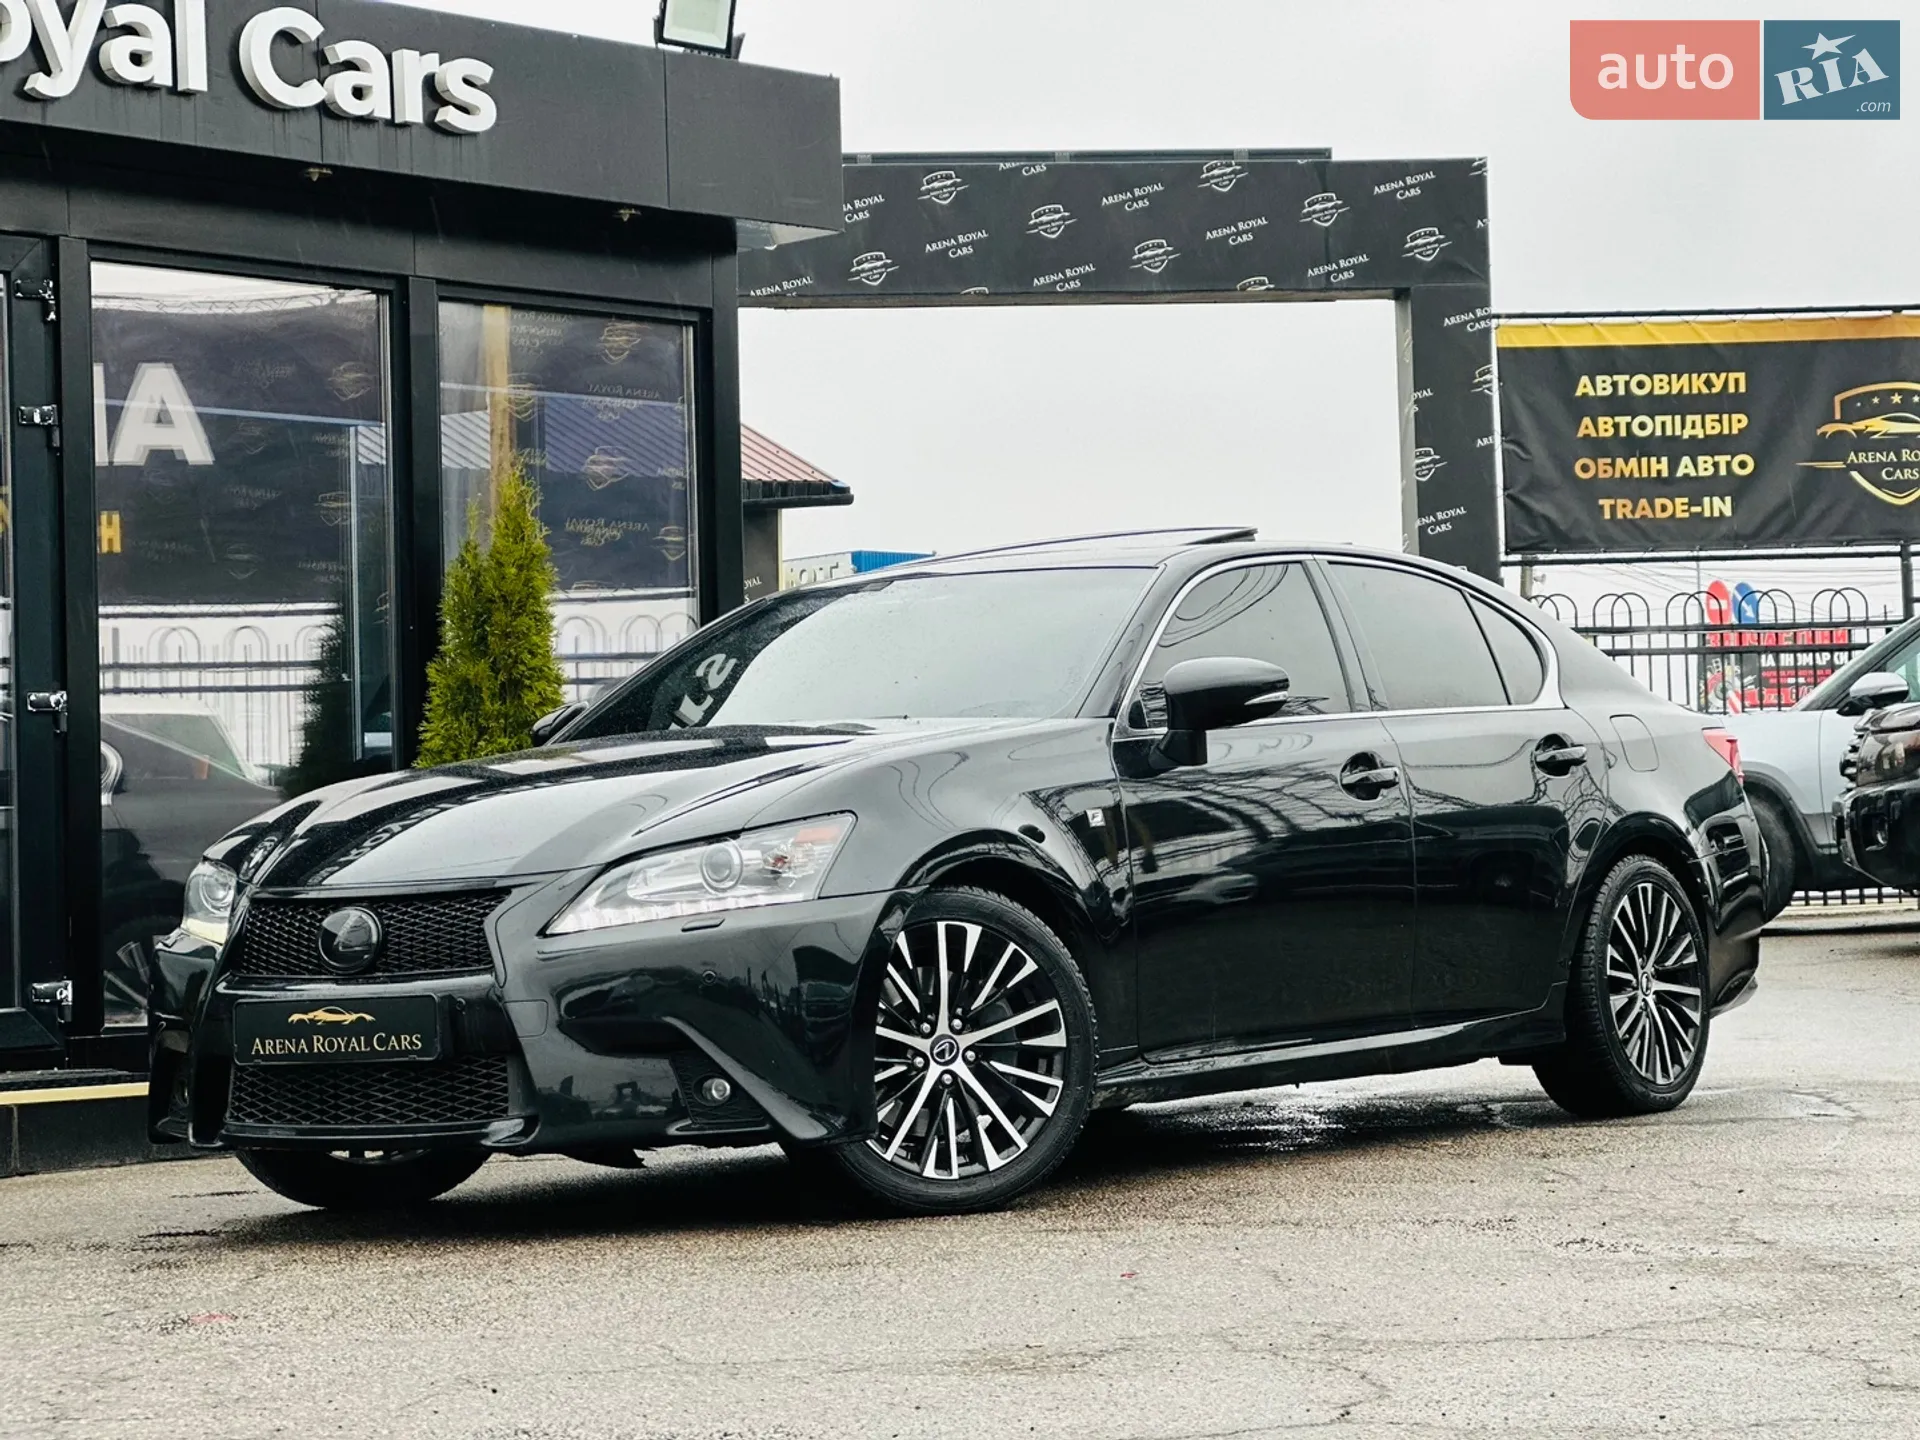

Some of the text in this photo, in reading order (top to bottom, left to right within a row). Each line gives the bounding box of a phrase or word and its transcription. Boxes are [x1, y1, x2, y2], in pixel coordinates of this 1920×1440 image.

[239, 6, 497, 134] Cars
[1373, 170, 1436, 196] ARENA ROYAL
[1101, 182, 1165, 206] ARENA ROYAL
[1396, 186, 1421, 199] CARS
[853, 194, 886, 209] ROYAL
[1125, 198, 1149, 211] CARS
[845, 210, 870, 223] CARS
[1206, 216, 1269, 240] ARENA ROYAL
[925, 229, 989, 253] ARENA ROYAL
[1228, 232, 1254, 246] CARS
[948, 245, 974, 258] CARS
[1307, 253, 1370, 277] ARENA ROYAL
[1033, 263, 1096, 287] ARENA ROYAL
[1330, 269, 1355, 282] CARS
[782, 276, 813, 290] ROYAL
[1055, 279, 1081, 292] CARS
[1443, 312, 1475, 327] ARENA
[1466, 318, 1492, 331] CARS
[1575, 372, 1746, 396] АВТОВИКУП
[1576, 413, 1749, 439] АВТОПІДБІР
[1847, 450, 1898, 464] ARENA
[1574, 454, 1755, 479] ОБМІН АВТО
[1881, 467, 1920, 480] CARS
[1436, 506, 1467, 520] ROYAL
[1598, 496, 1732, 520] TRADE-IN
[1427, 521, 1453, 535] CARS
[251, 1032, 423, 1055] ARENA ROYAL CARS
